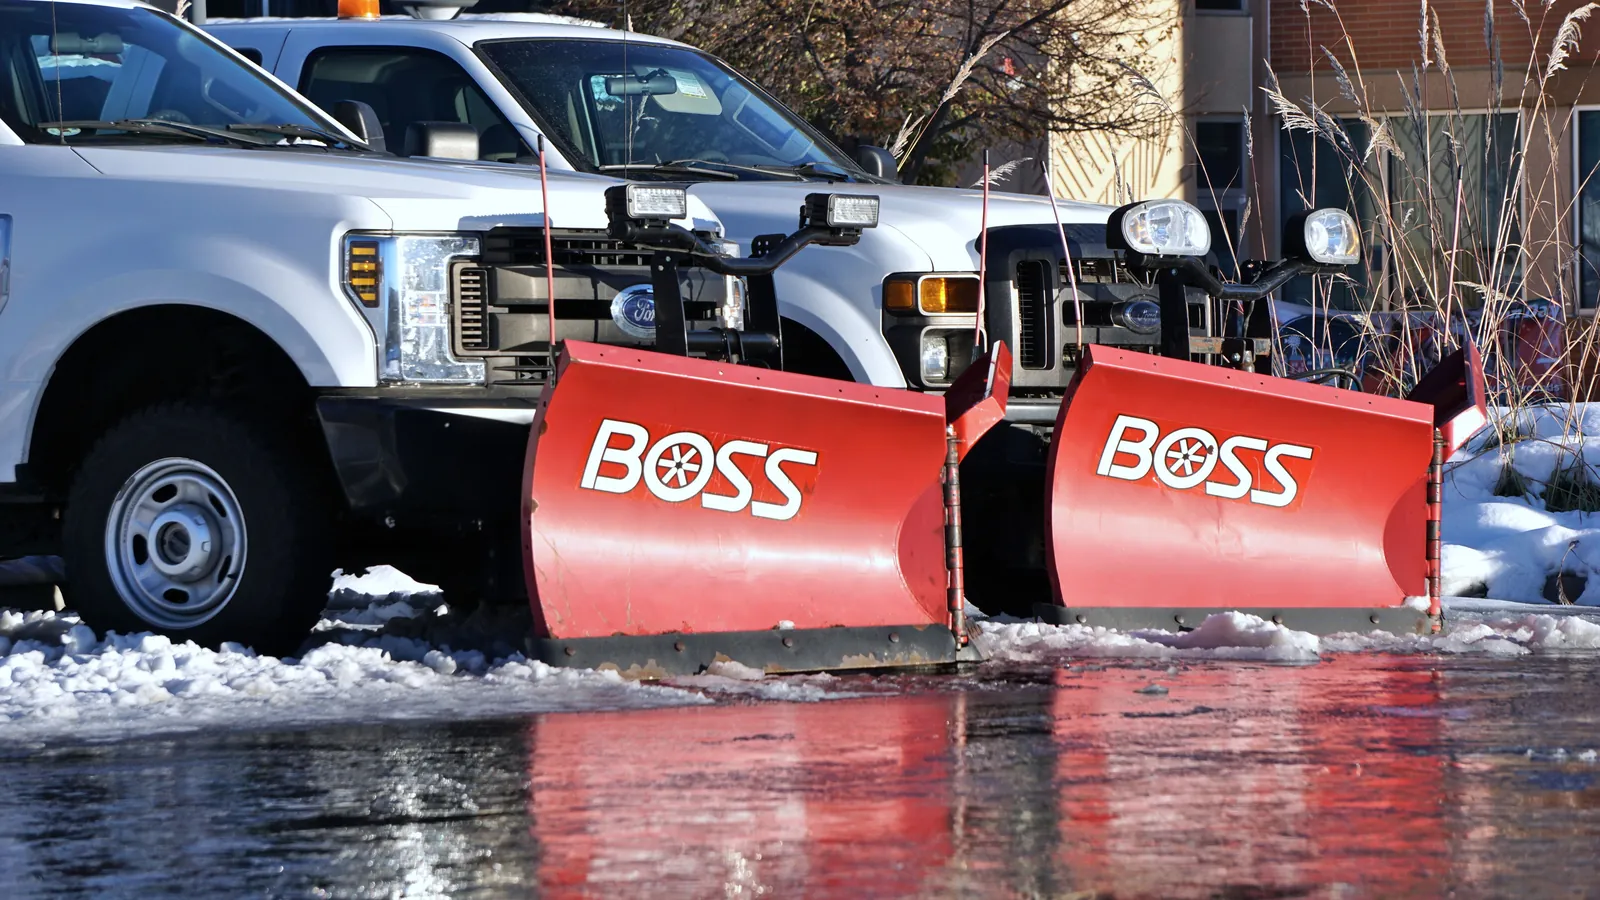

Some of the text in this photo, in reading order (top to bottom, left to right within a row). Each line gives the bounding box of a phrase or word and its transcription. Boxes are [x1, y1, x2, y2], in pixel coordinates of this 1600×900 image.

[634, 297, 656, 322] For
[580, 418, 818, 521] BOSS
[1096, 413, 1314, 508] BOSS
